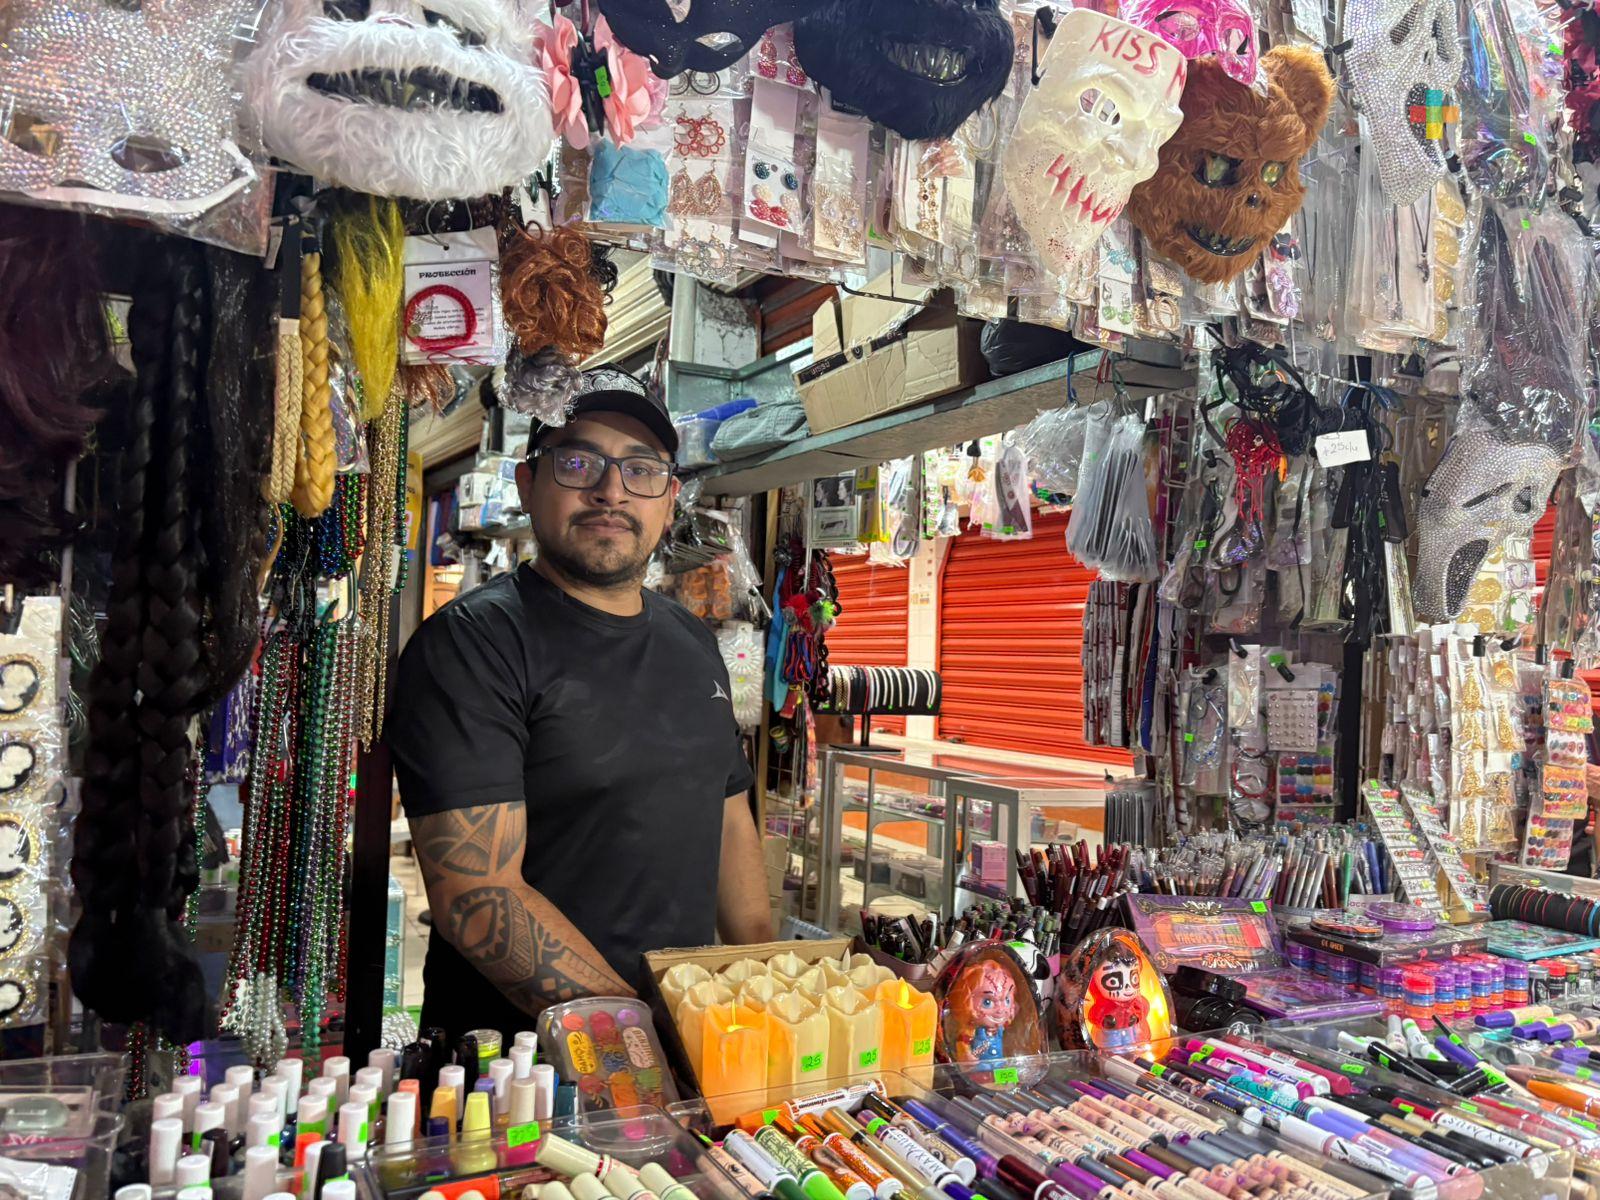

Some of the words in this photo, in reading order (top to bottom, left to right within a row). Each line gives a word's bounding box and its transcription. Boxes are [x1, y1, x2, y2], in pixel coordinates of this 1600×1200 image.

[1089, 20, 1167, 75] KISS
[419, 267, 476, 279] PROTECCIÓN
[807, 1055, 822, 1068] 25
[866, 1050, 878, 1064] 25
